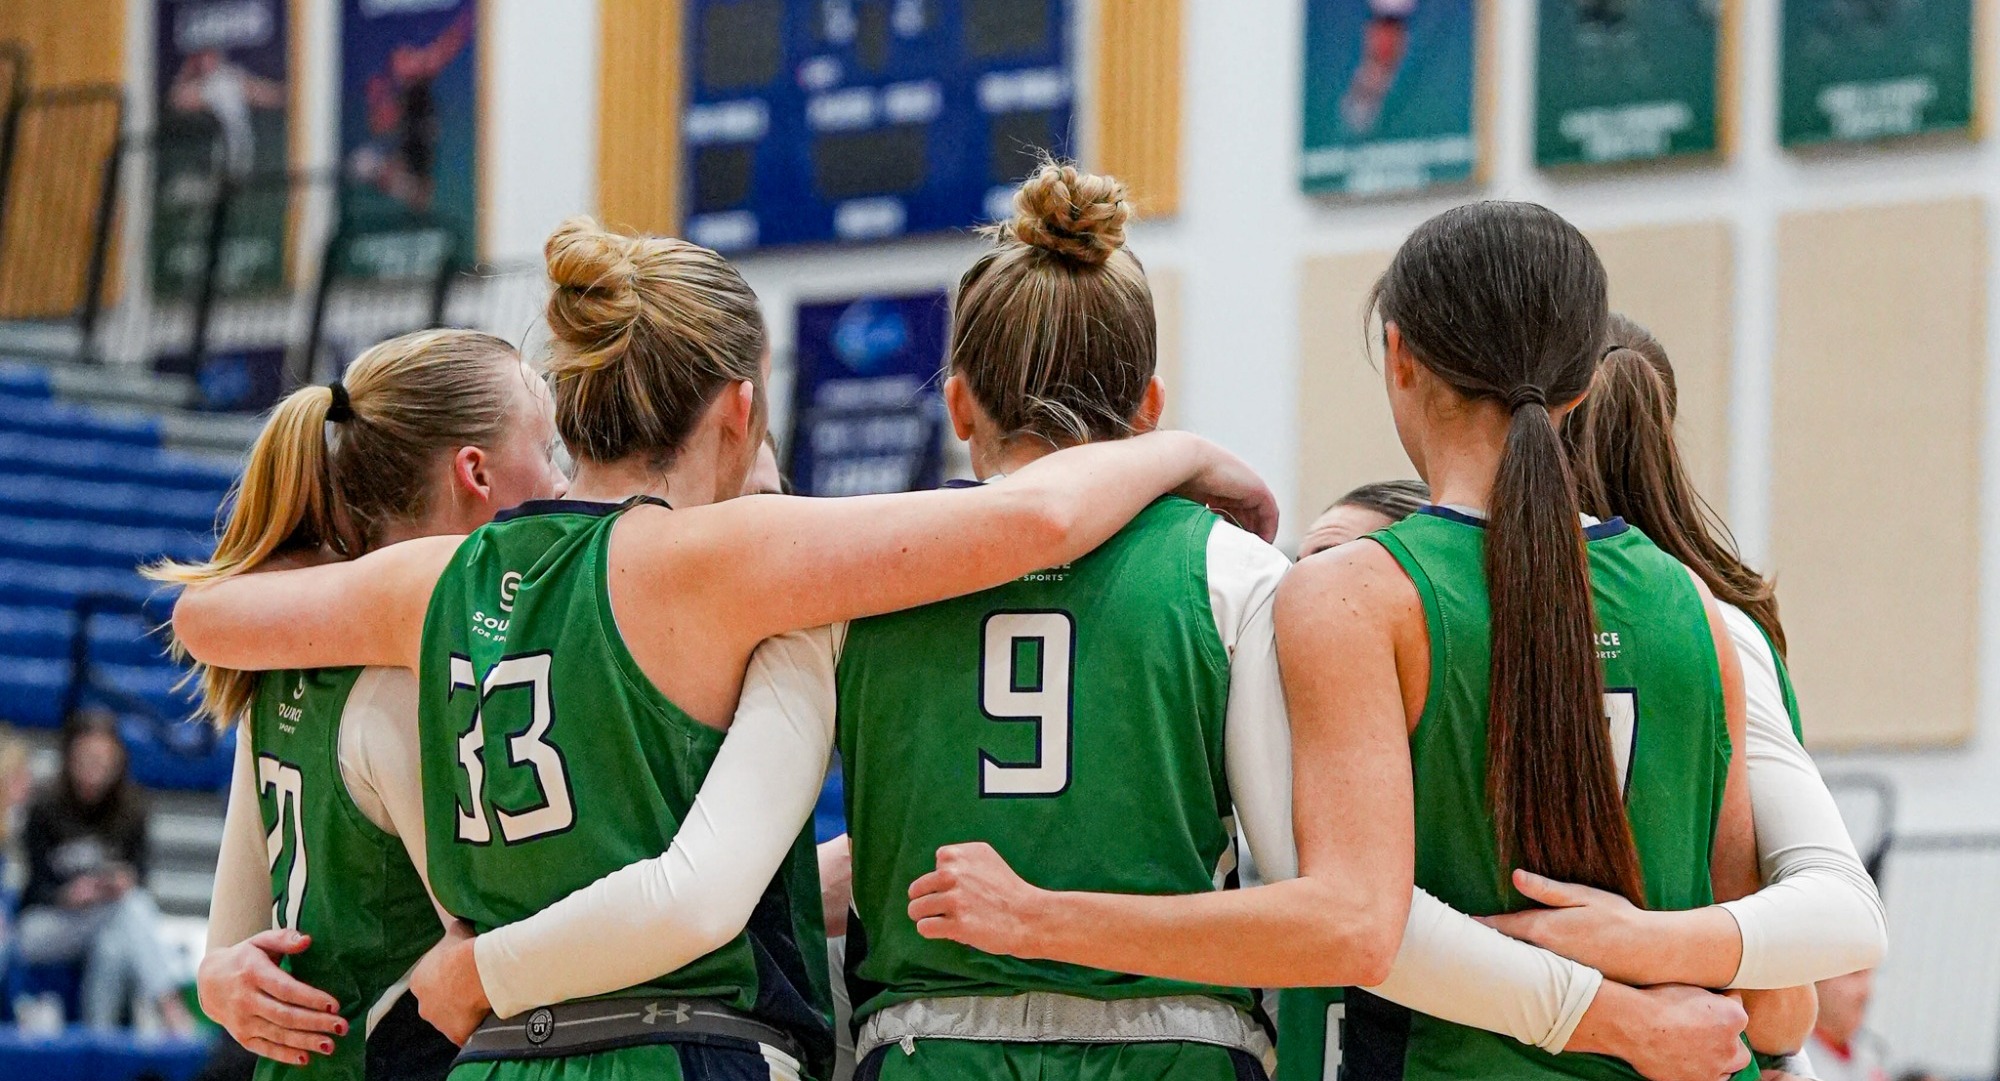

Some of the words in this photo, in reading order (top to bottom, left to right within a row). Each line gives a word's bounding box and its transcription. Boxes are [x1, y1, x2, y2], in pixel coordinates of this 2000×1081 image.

[472, 611, 510, 631] SOU
[472, 625, 491, 638] FOR
[448, 649, 577, 846] 33
[979, 608, 1076, 798] 9
